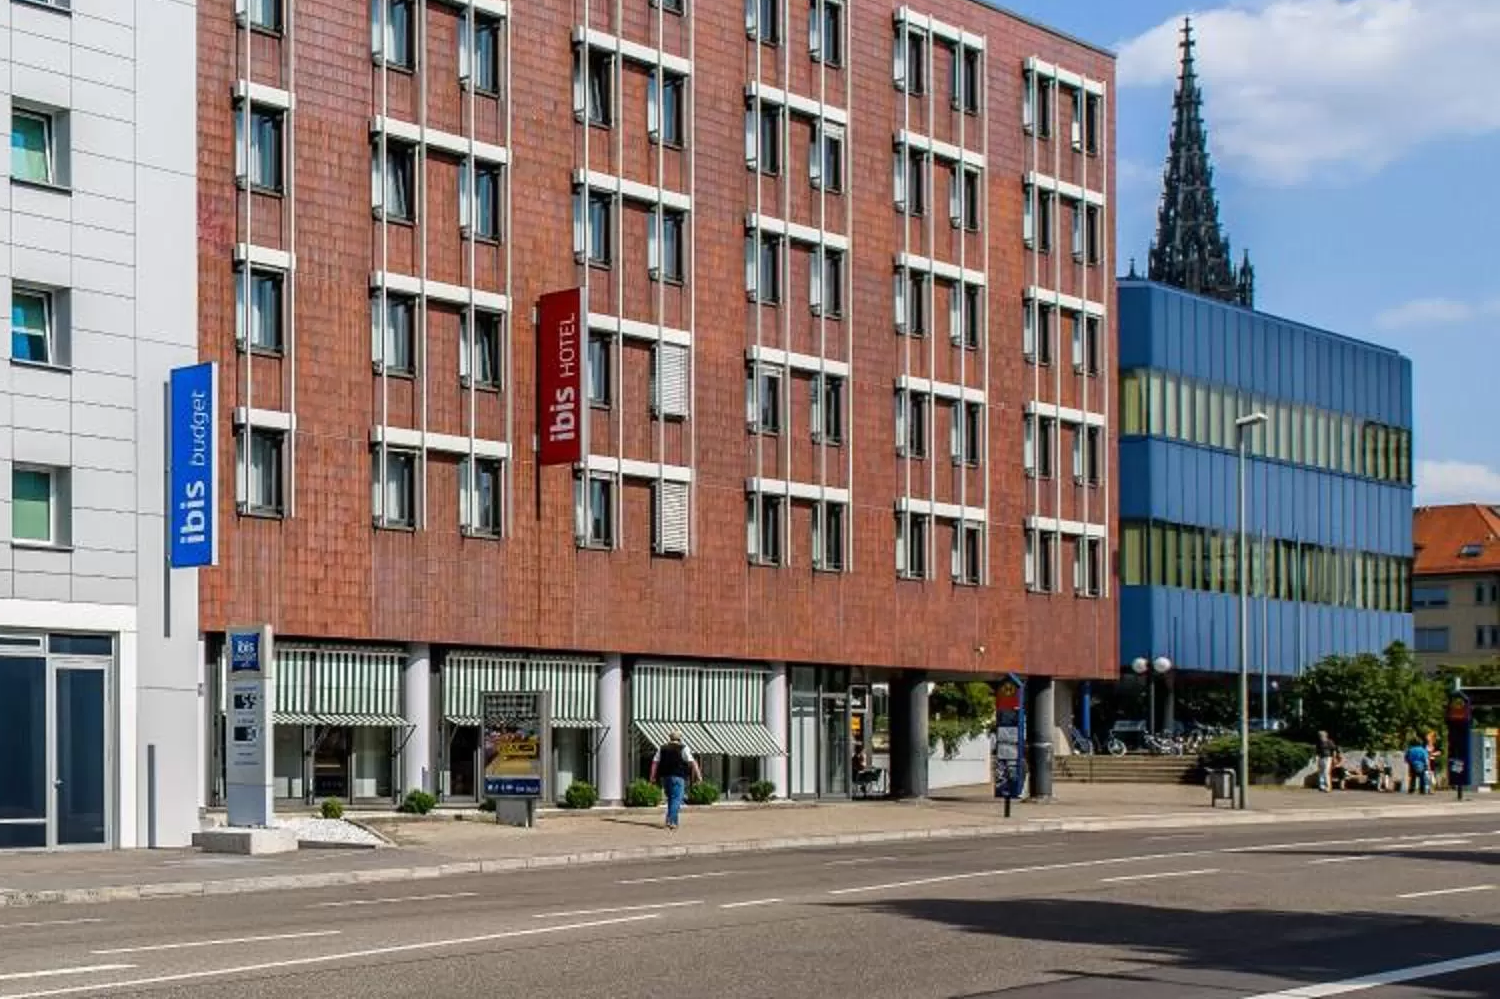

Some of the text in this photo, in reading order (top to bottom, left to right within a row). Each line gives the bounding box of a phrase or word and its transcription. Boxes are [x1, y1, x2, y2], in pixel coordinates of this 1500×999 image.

[550, 313, 575, 442] ibis HOTEL
[180, 389, 209, 544] ibis budget
